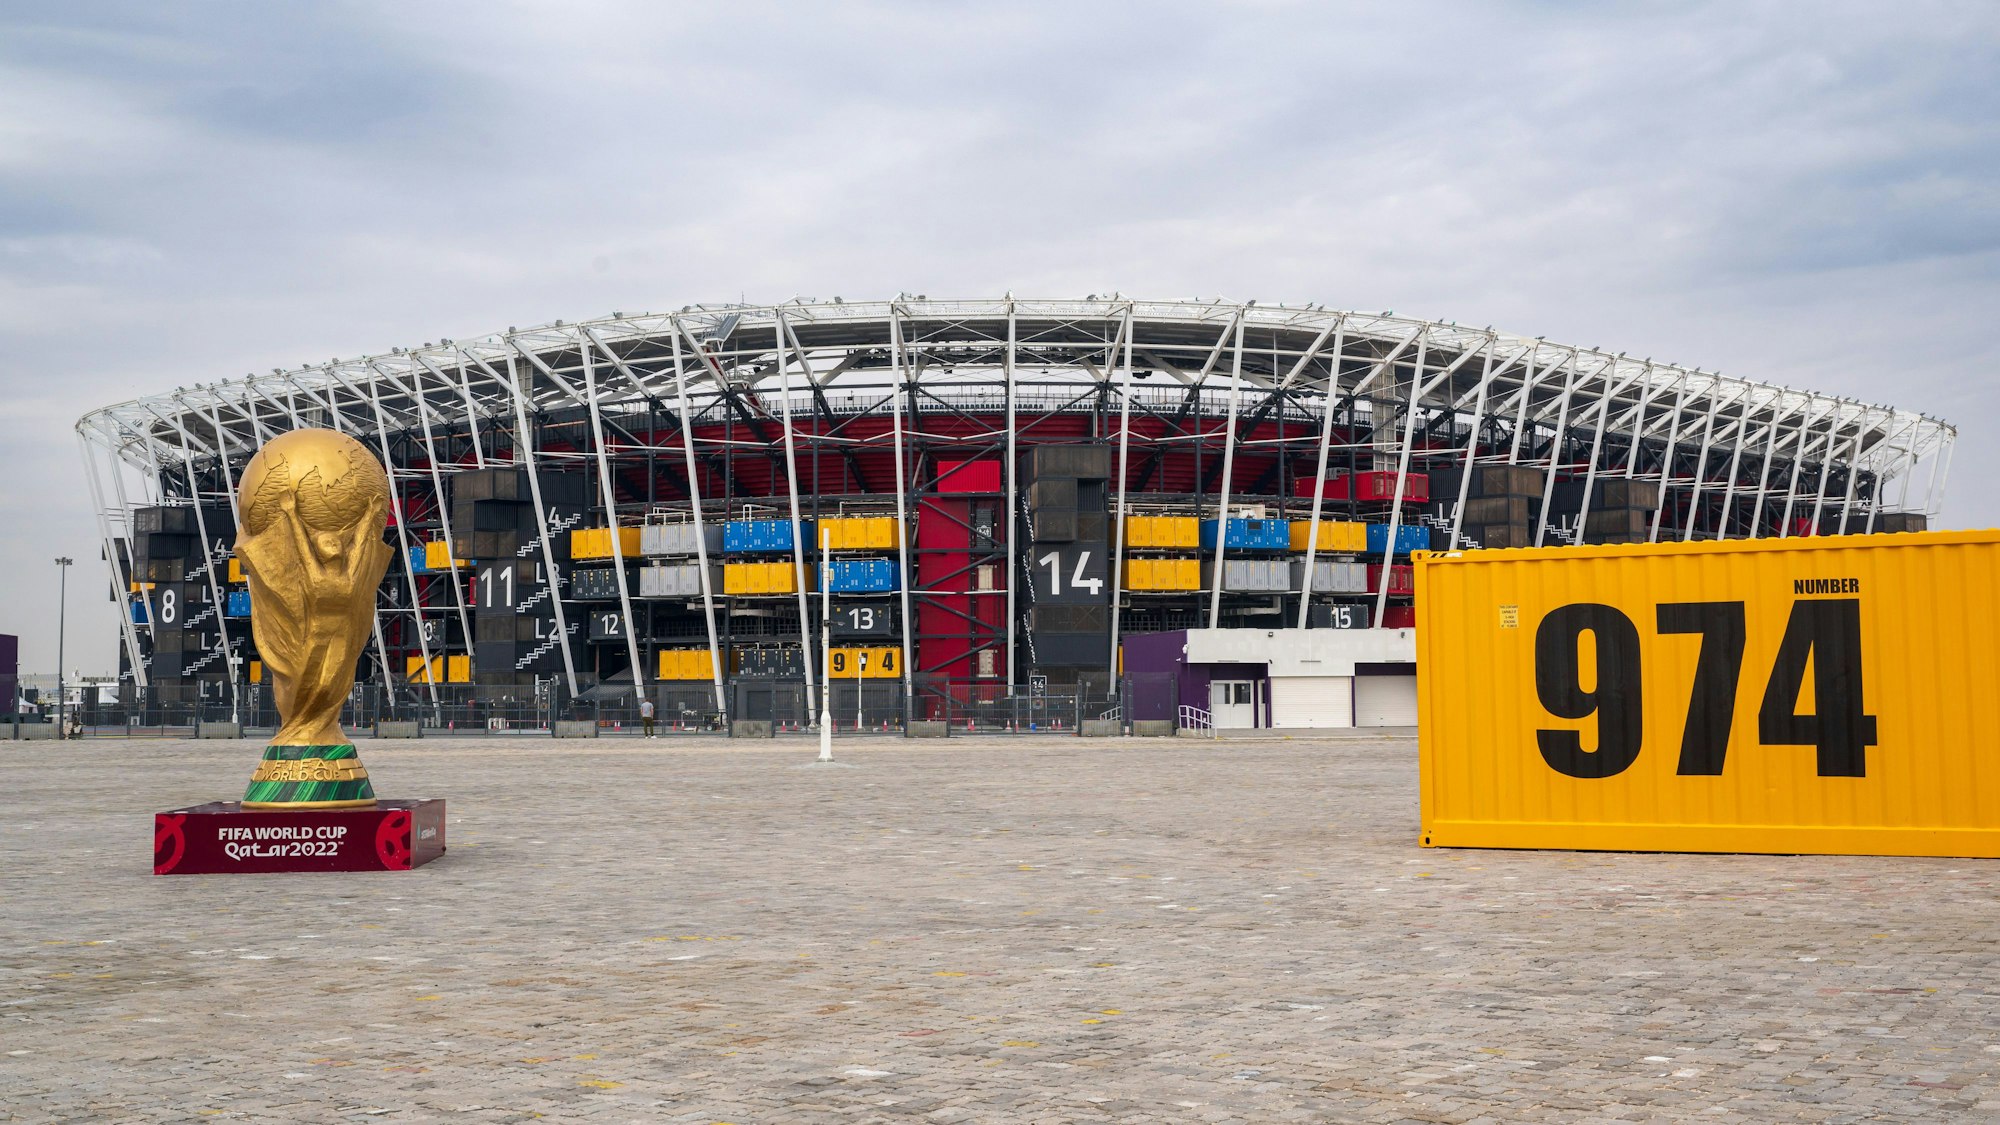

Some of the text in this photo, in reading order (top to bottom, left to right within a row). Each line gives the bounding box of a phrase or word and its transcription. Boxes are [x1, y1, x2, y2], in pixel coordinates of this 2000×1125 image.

[1039, 551, 1104, 595] 14
[480, 566, 512, 608] 11
[1794, 578, 1860, 595] NUMBER
[161, 589, 176, 624] 8
[602, 614, 619, 635] 12
[848, 607, 874, 630] 13
[1332, 606, 1352, 629] 15
[200, 680, 224, 698] L1
[1032, 680, 1044, 689] 14
[1535, 599, 1878, 779] 974
[263, 769, 341, 781] WORLD CUP
[273, 760, 327, 770] FIFA
[218, 826, 348, 840] FIFA WORLD CUP
